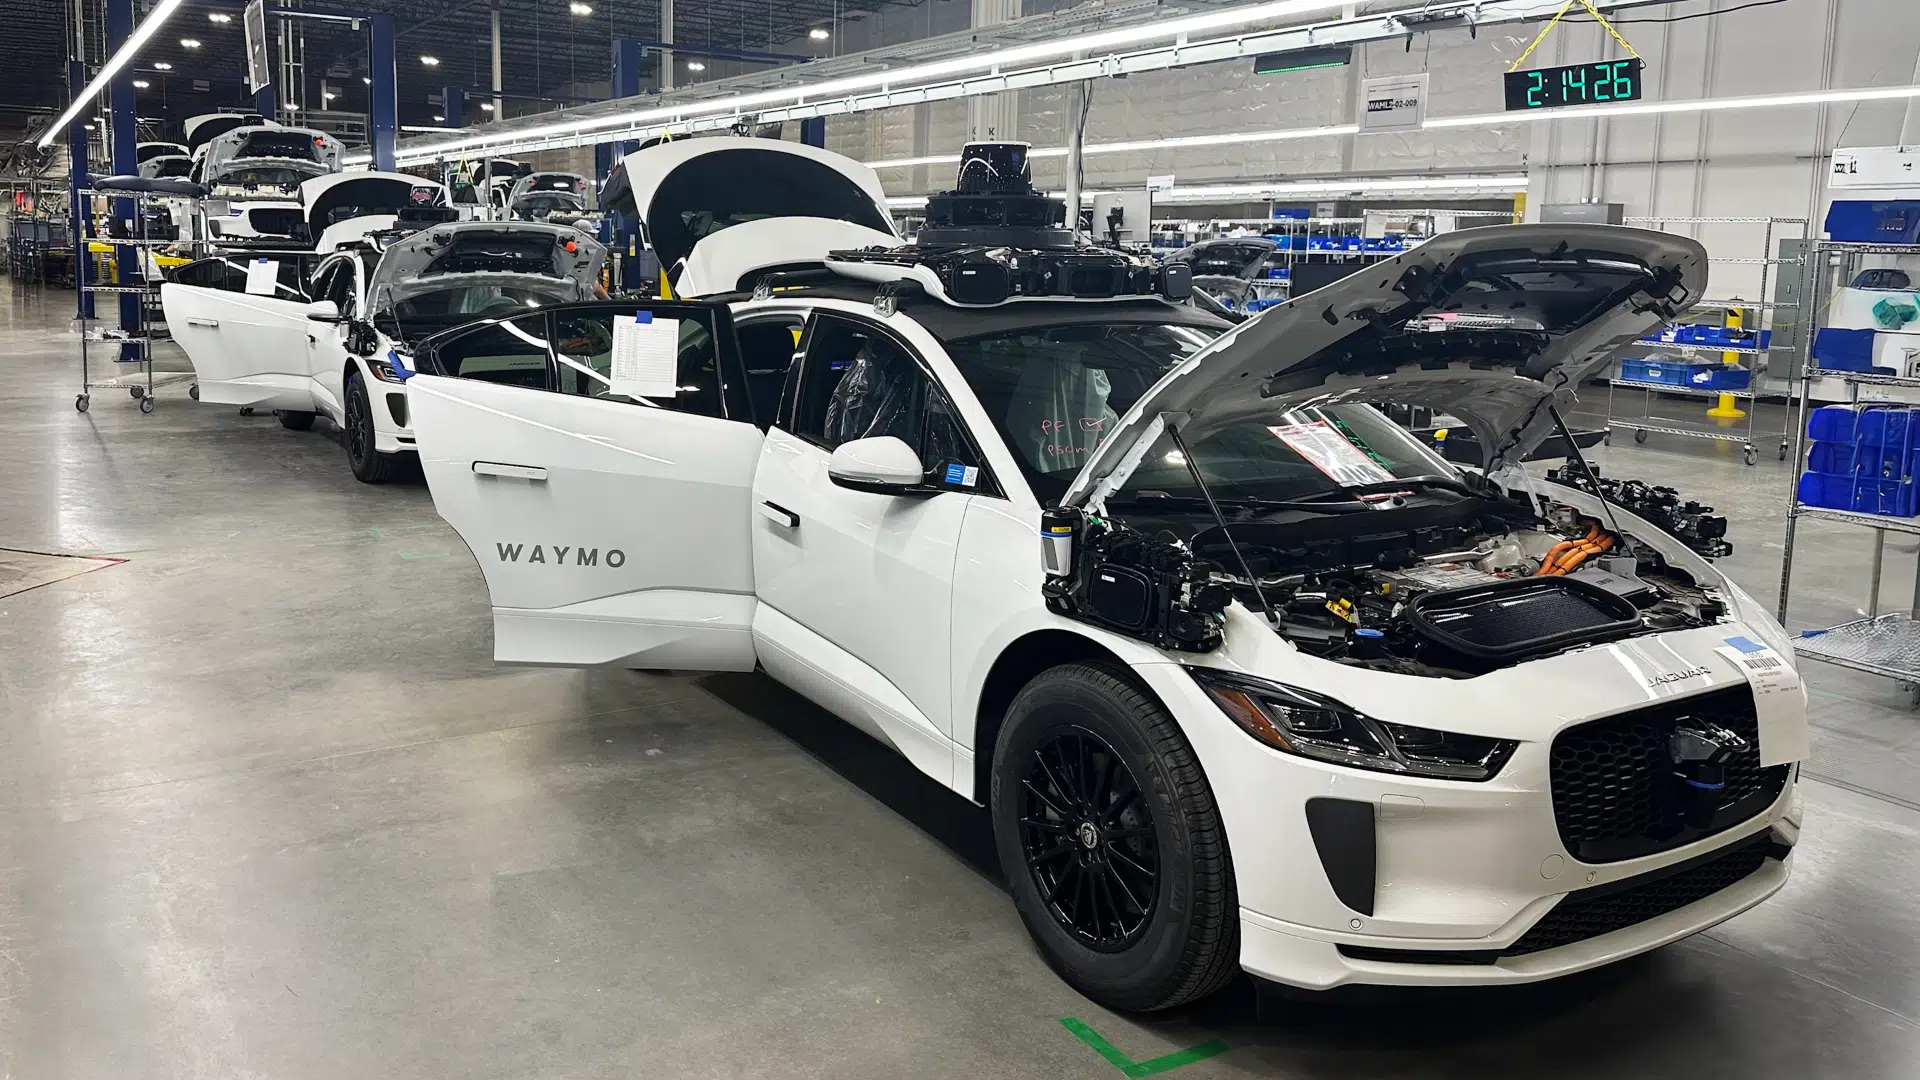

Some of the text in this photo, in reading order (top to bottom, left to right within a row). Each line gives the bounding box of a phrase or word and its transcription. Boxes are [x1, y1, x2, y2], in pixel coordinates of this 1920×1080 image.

[1594, 62, 1631, 100] 26
[496, 542, 626, 568] WAYMO
[1648, 666, 1712, 688] JAGUAR
